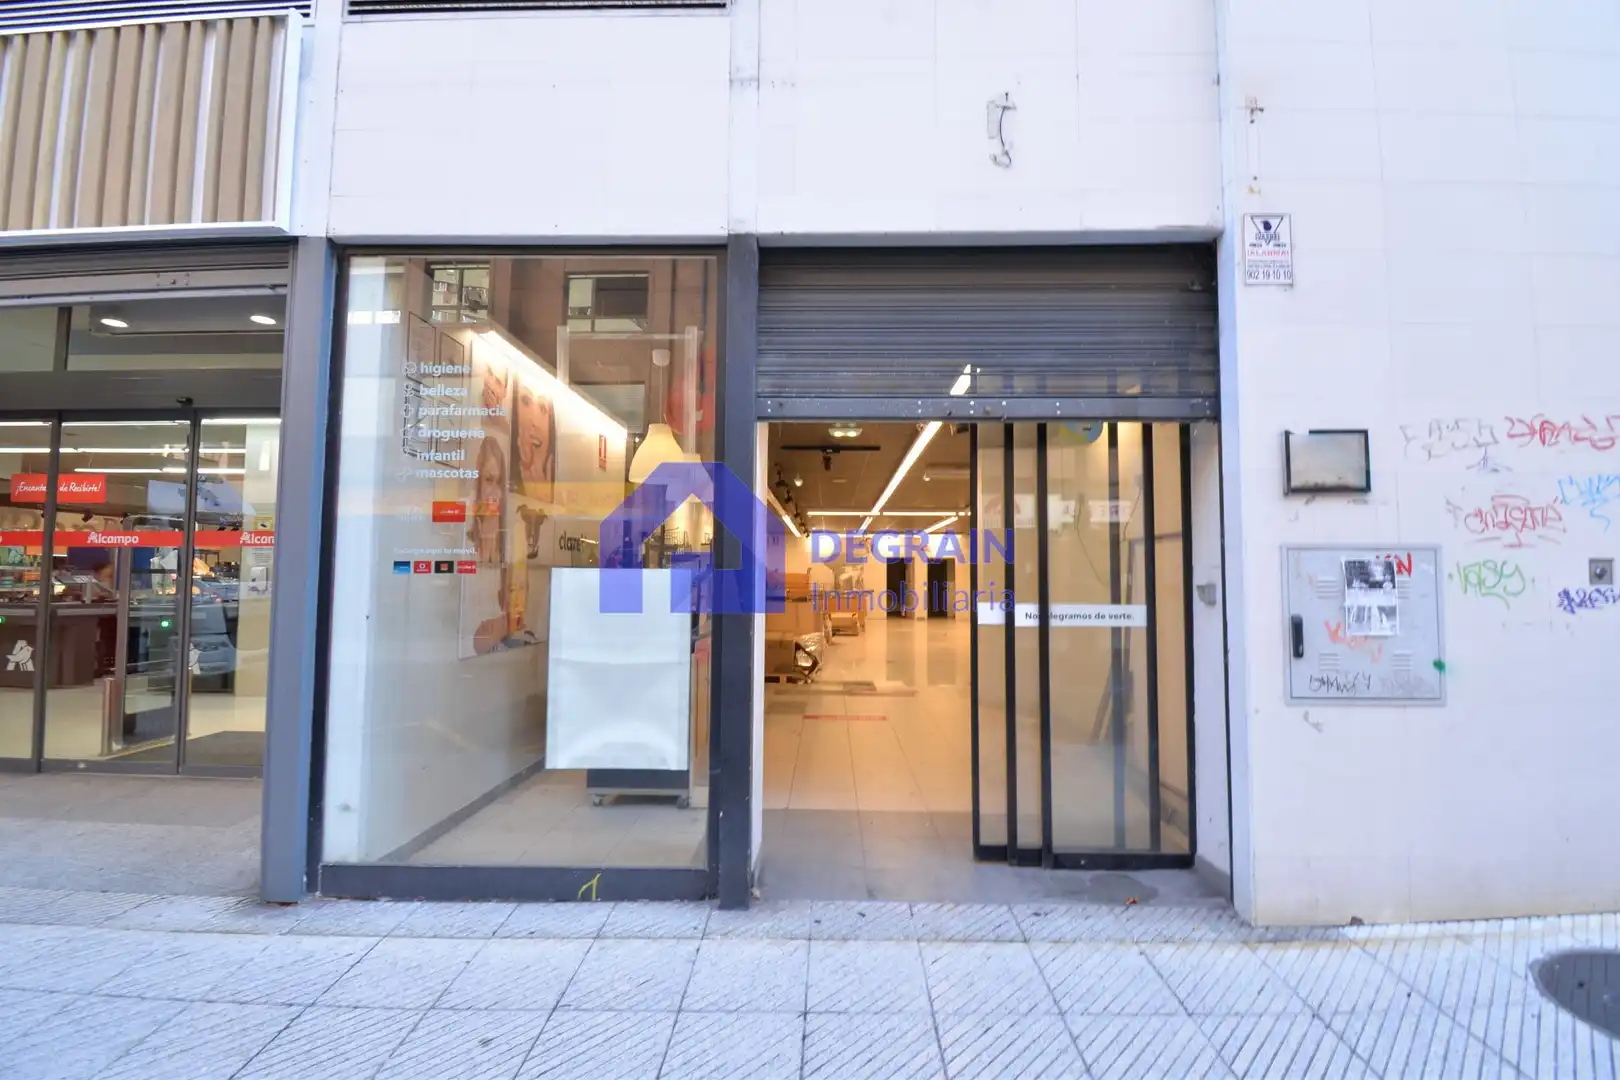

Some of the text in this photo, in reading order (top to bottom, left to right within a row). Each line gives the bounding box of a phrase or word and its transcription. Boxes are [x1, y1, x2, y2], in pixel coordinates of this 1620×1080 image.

[1273, 271, 1281, 281] 10
[1283, 271, 1292, 281] 10
[420, 362, 471, 377] higiene
[420, 384, 468, 397] belleza
[418, 404, 506, 420] parafarmacia
[416, 449, 466, 461] infantil
[416, 468, 480, 478] mascotas
[87, 531, 139, 546] Alcampo
[1025, 612, 1040, 621] No
[1050, 611, 1092, 622] legramos
[1094, 611, 1106, 620] de
